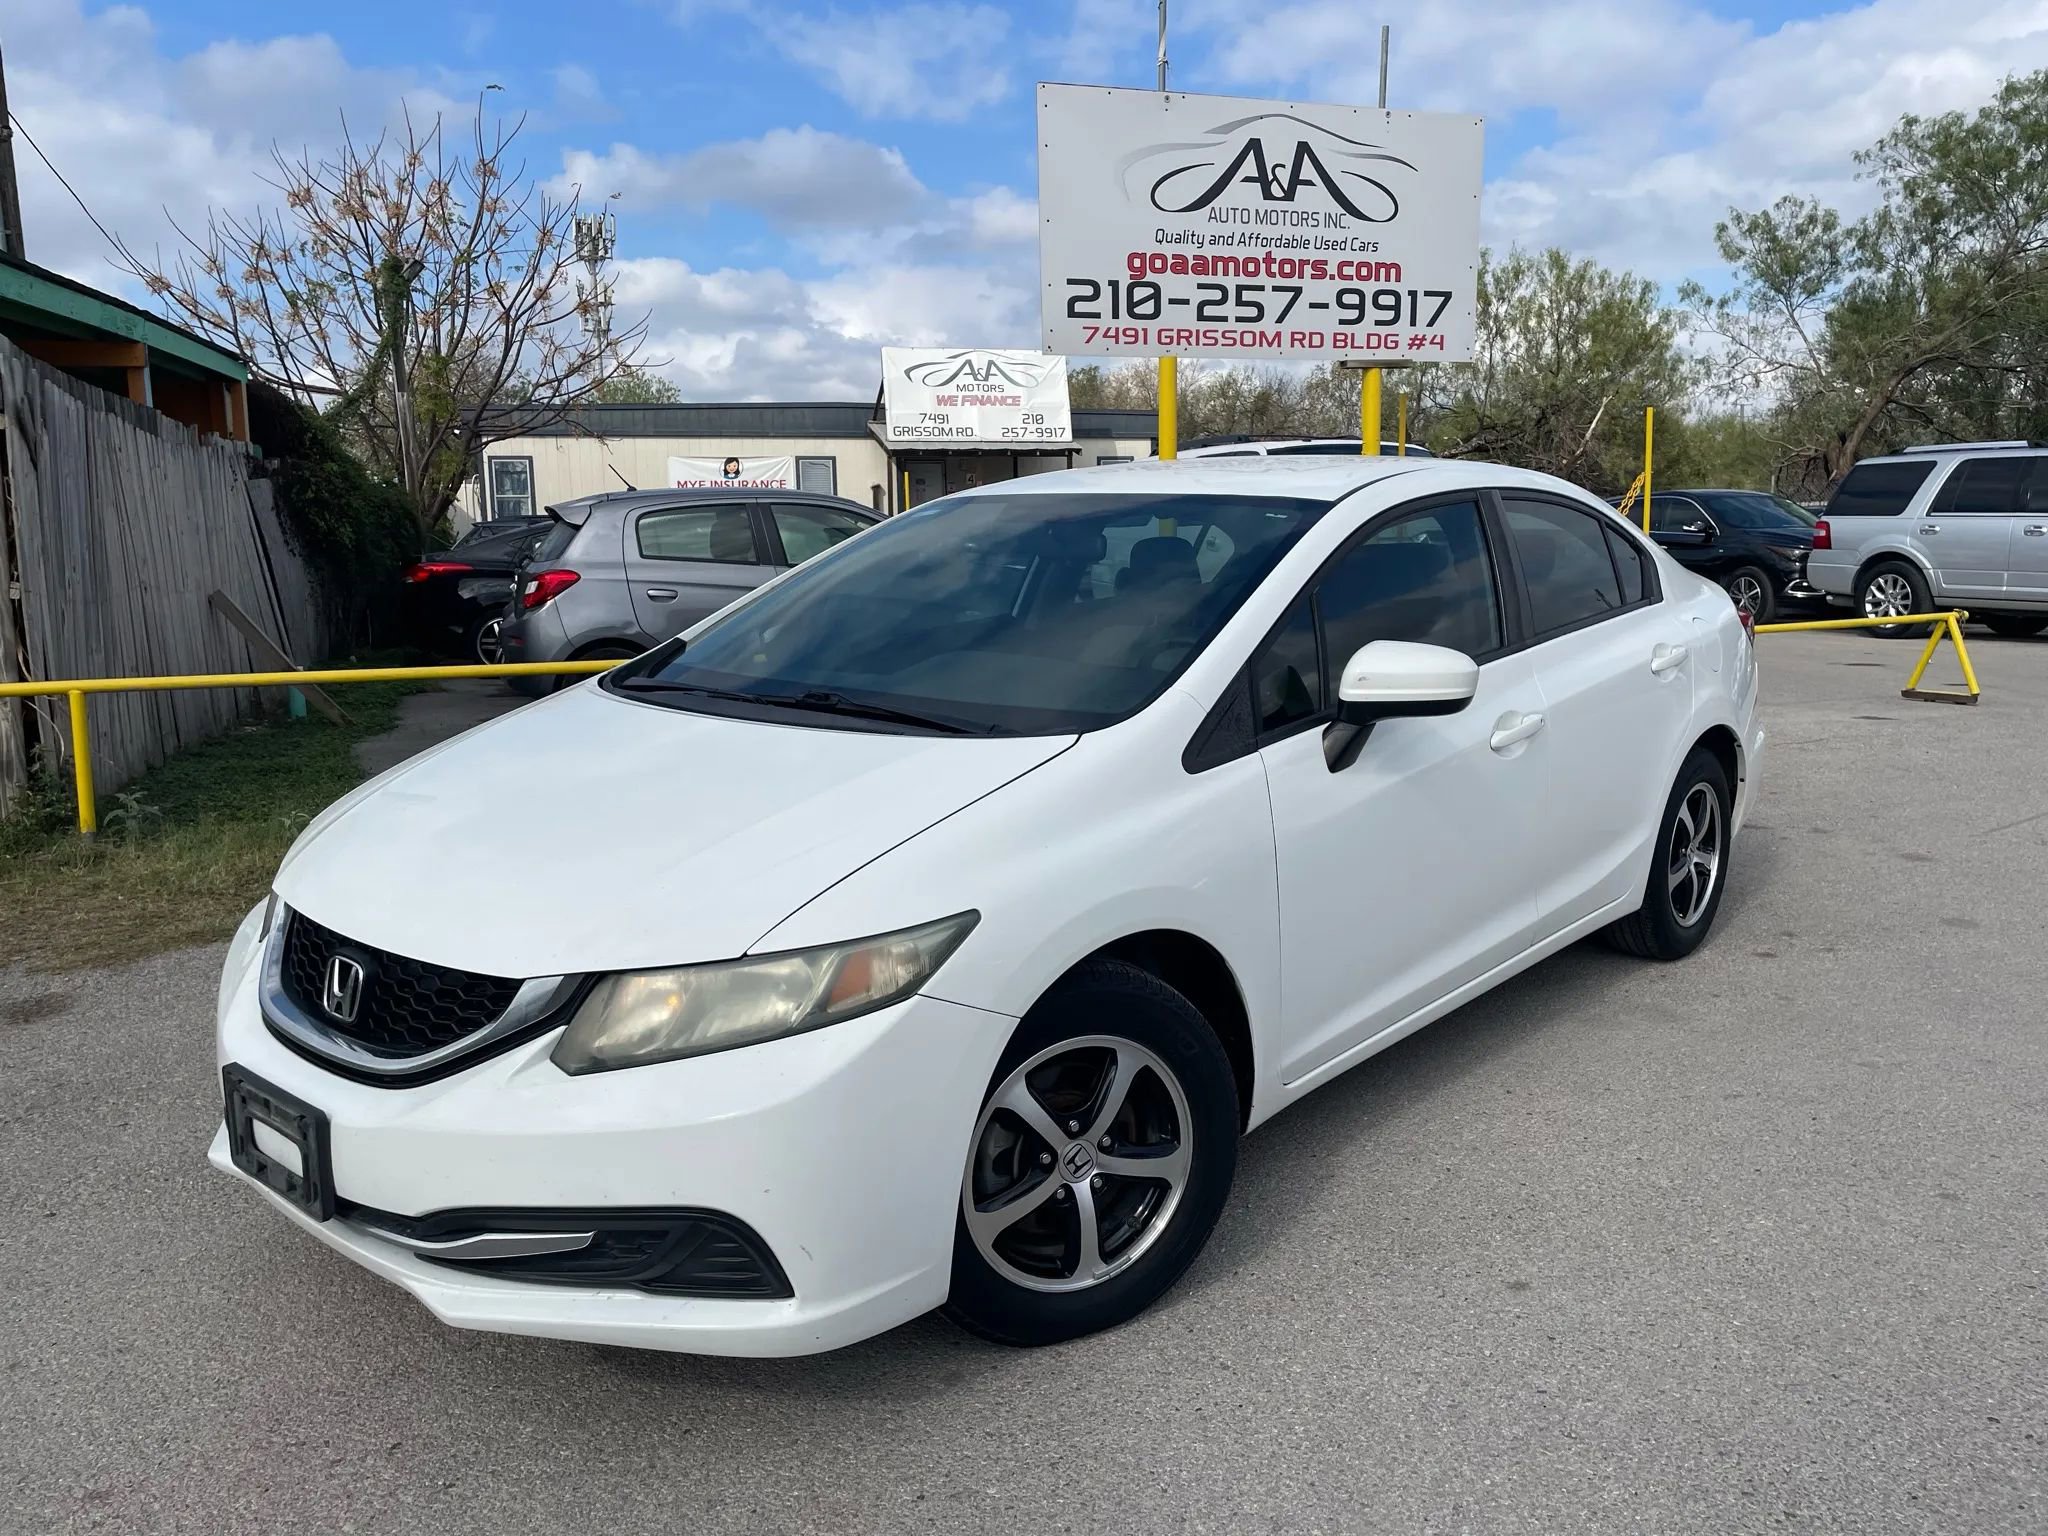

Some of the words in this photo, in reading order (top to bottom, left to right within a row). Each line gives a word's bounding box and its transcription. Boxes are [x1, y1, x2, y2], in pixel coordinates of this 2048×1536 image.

[1185, 138, 1368, 215] A&A
[1207, 206, 1251, 225] AUTO
[1254, 208, 1320, 228] MOTORS
[1324, 212, 1351, 230] INC.
[1154, 228, 1205, 249] Quality
[1208, 231, 1235, 247] and
[1237, 231, 1311, 250] Affordable
[1314, 235, 1348, 252] Used
[1350, 238, 1379, 253] Cars
[1127, 250, 1402, 283] goaamotors.com
[1066, 278, 1453, 327] 210-257-9917
[1082, 326, 1149, 345] 7491
[1157, 328, 1282, 349] GRISSOM
[1290, 331, 1325, 349] RD
[1332, 332, 1400, 350] BLDG
[1407, 334, 1445, 351] #4
[936, 359, 1027, 387] A&A
[956, 383, 1005, 393] MOTORS
[936, 394, 958, 407] WE
[961, 395, 1022, 407] FINANCE
[919, 413, 949, 425] 7491
[1022, 413, 1044, 425] 210
[893, 426, 953, 437] GRISSOM
[956, 426, 977, 437] RD.
[1001, 427, 1066, 438] 257-9917
[710, 480, 787, 489] INSURANCE
